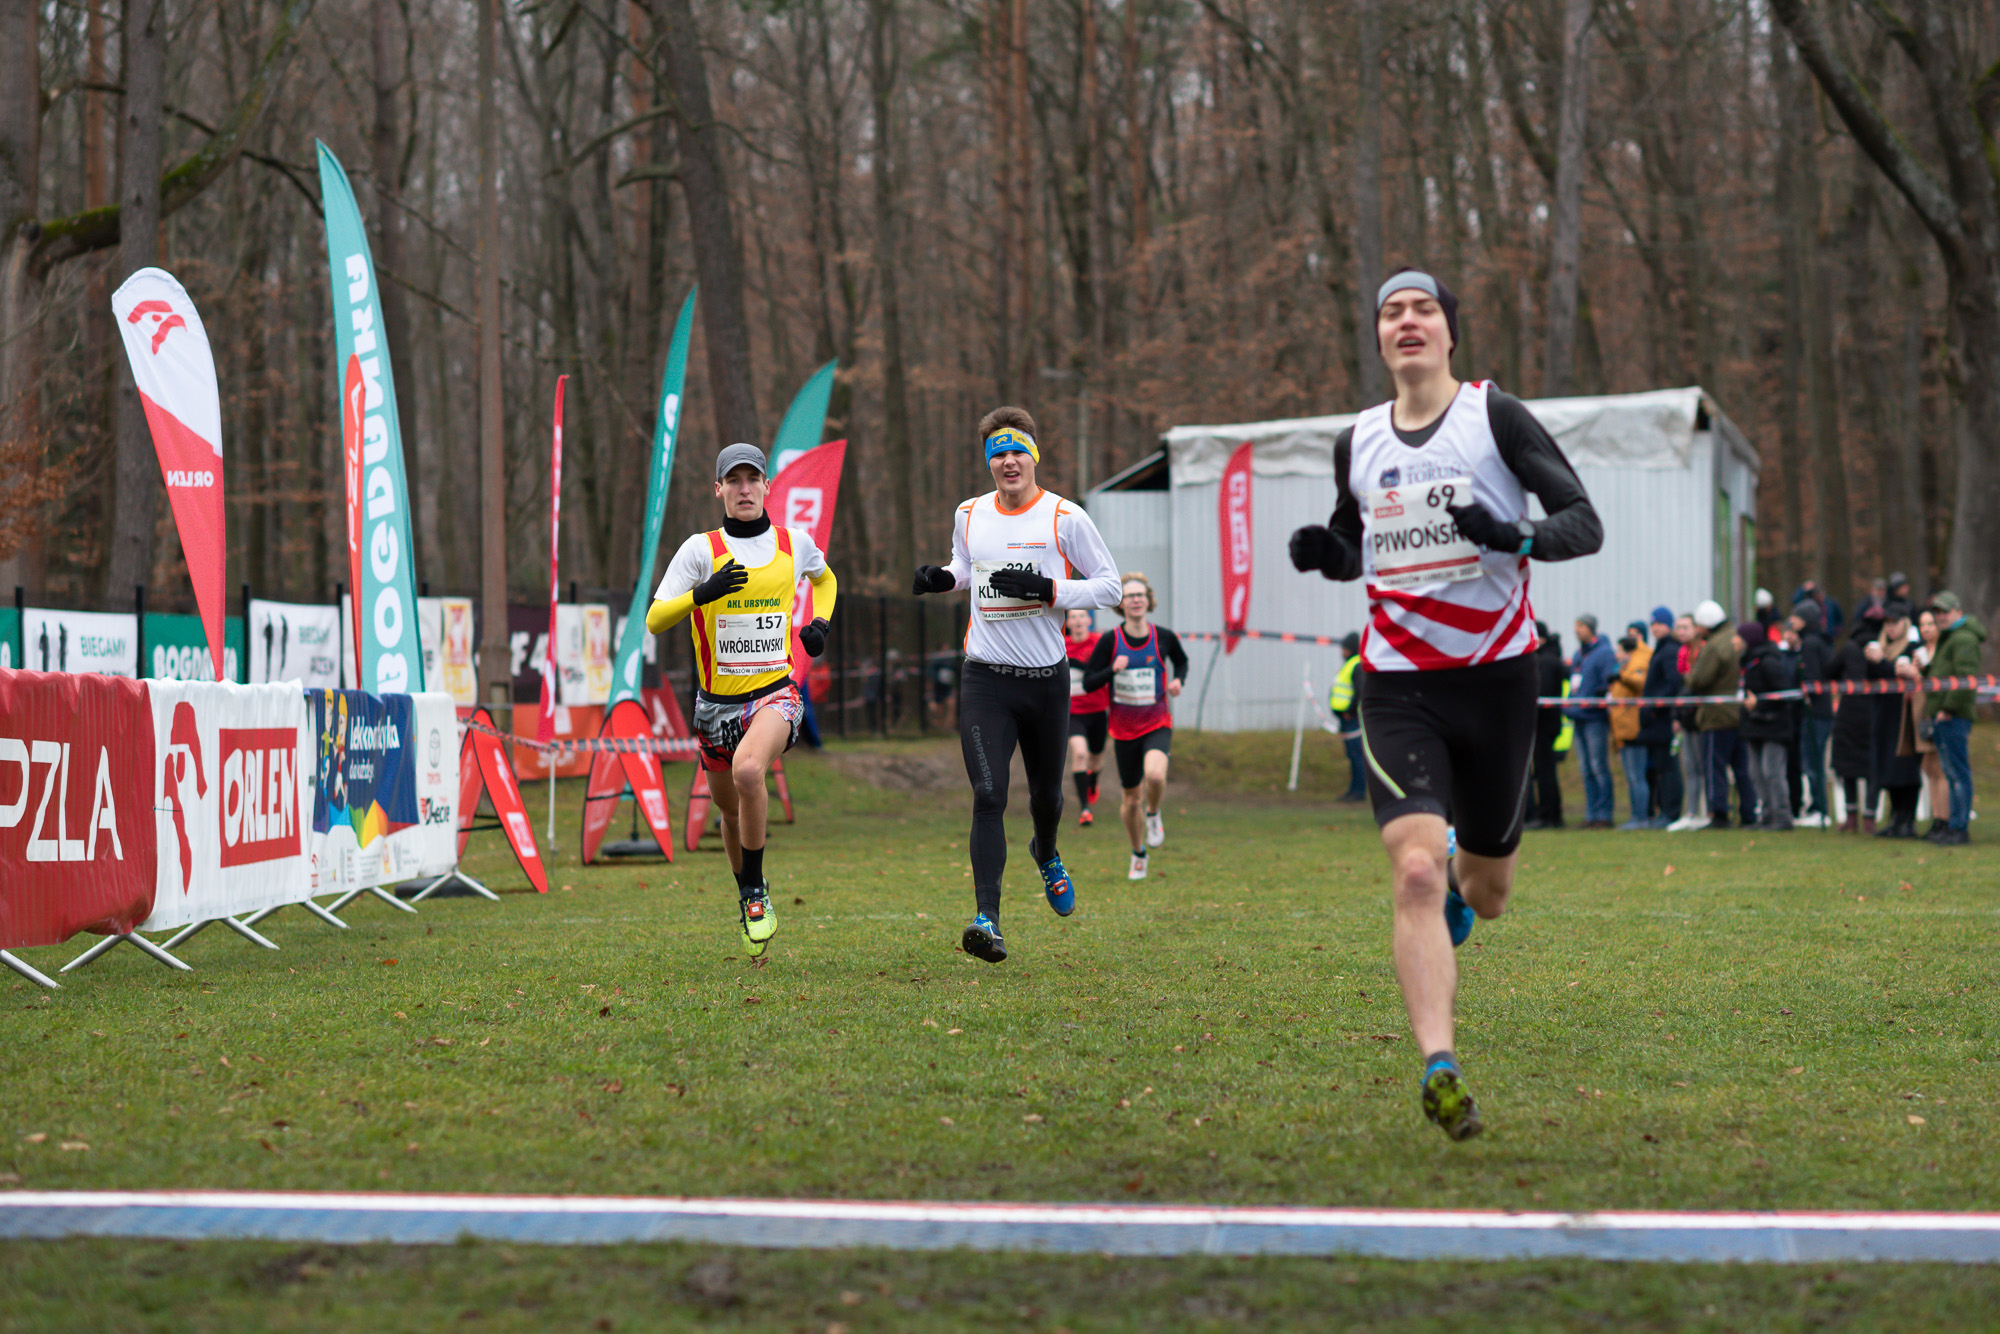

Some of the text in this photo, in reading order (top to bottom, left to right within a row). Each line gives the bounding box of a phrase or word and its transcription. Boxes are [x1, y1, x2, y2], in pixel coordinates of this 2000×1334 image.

[345, 253, 408, 694] BOGDANKA
[1426, 484, 1455, 508] 69
[1374, 520, 1466, 554] PIWOŃSK
[727, 599, 742, 608] AKL
[755, 615, 783, 630] 157
[80, 636, 127, 658] BIEGAMY
[719, 636, 784, 653] WRÓBLEWSKI
[224, 748, 297, 848] ORLEN
